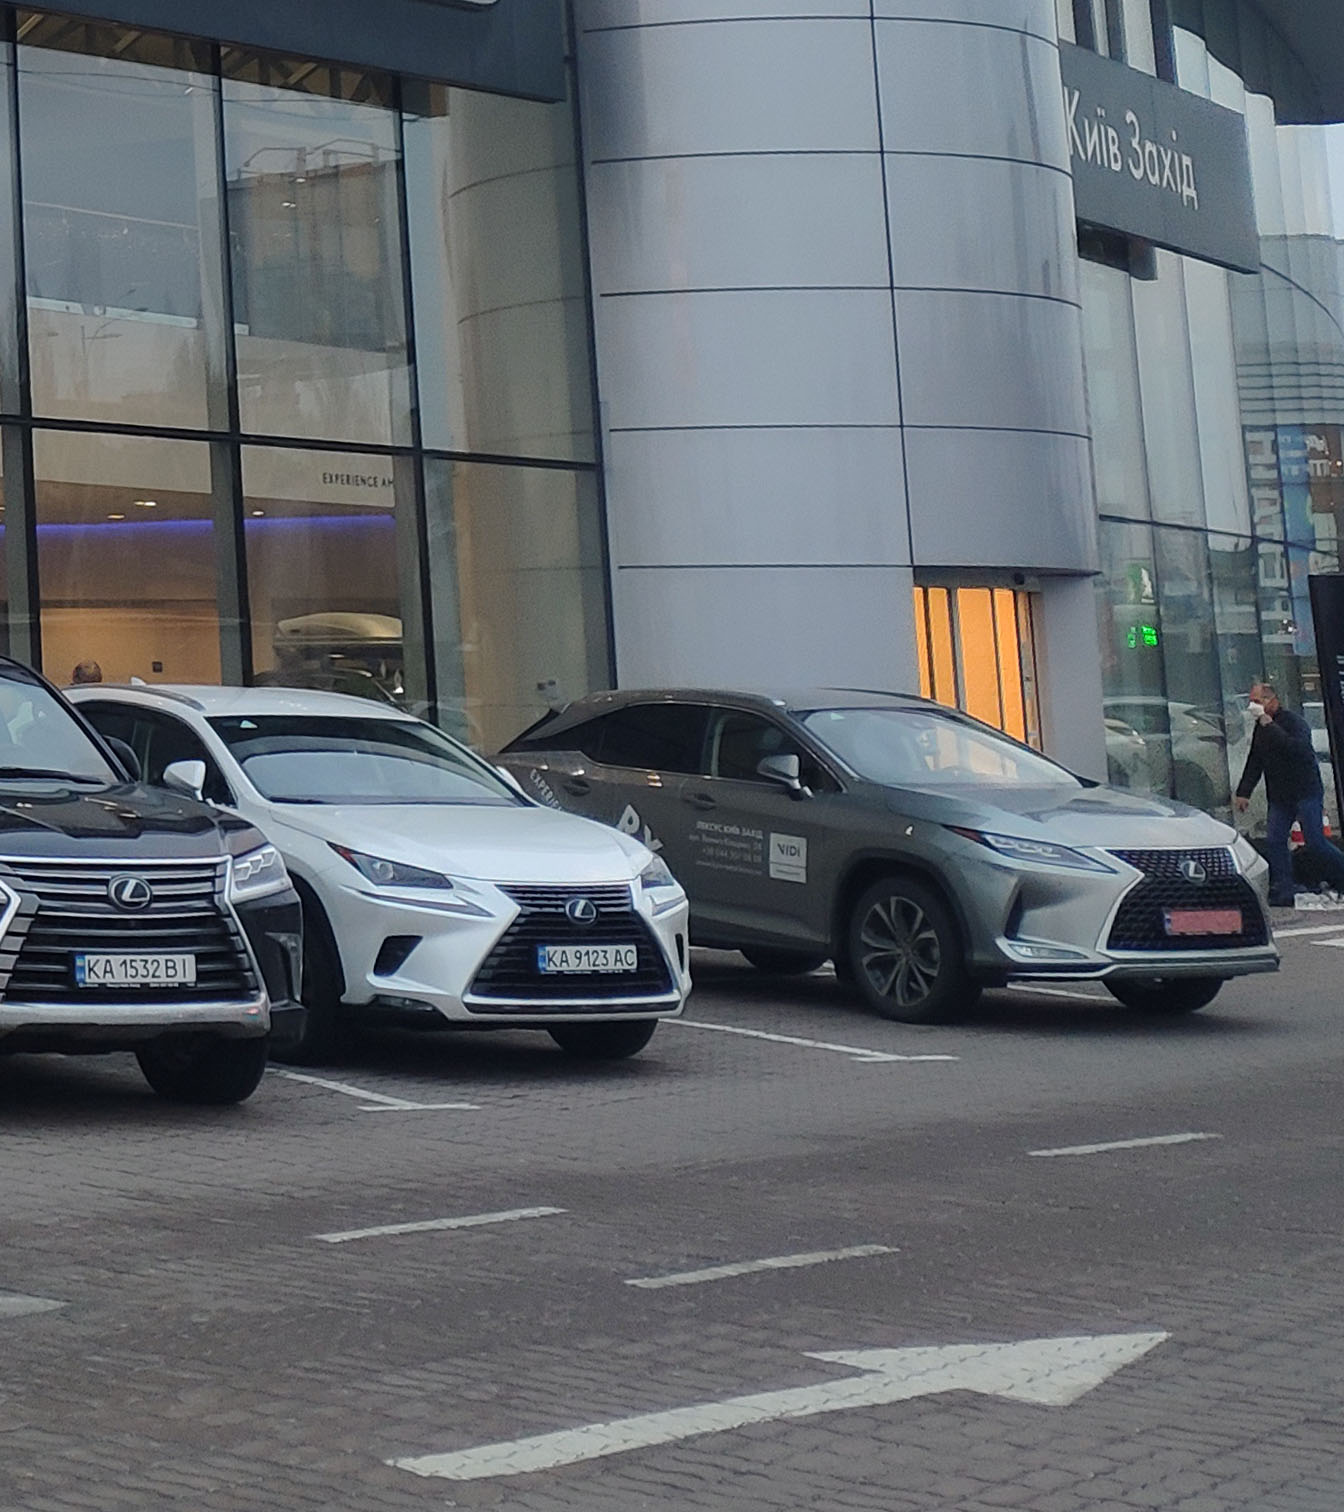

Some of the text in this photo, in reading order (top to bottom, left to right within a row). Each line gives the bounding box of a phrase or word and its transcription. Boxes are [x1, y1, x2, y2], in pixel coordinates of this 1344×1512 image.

[1063, 86, 1199, 211] Київ Захід
[119, 958, 161, 979] 1532
[574, 949, 609, 968] 9123
